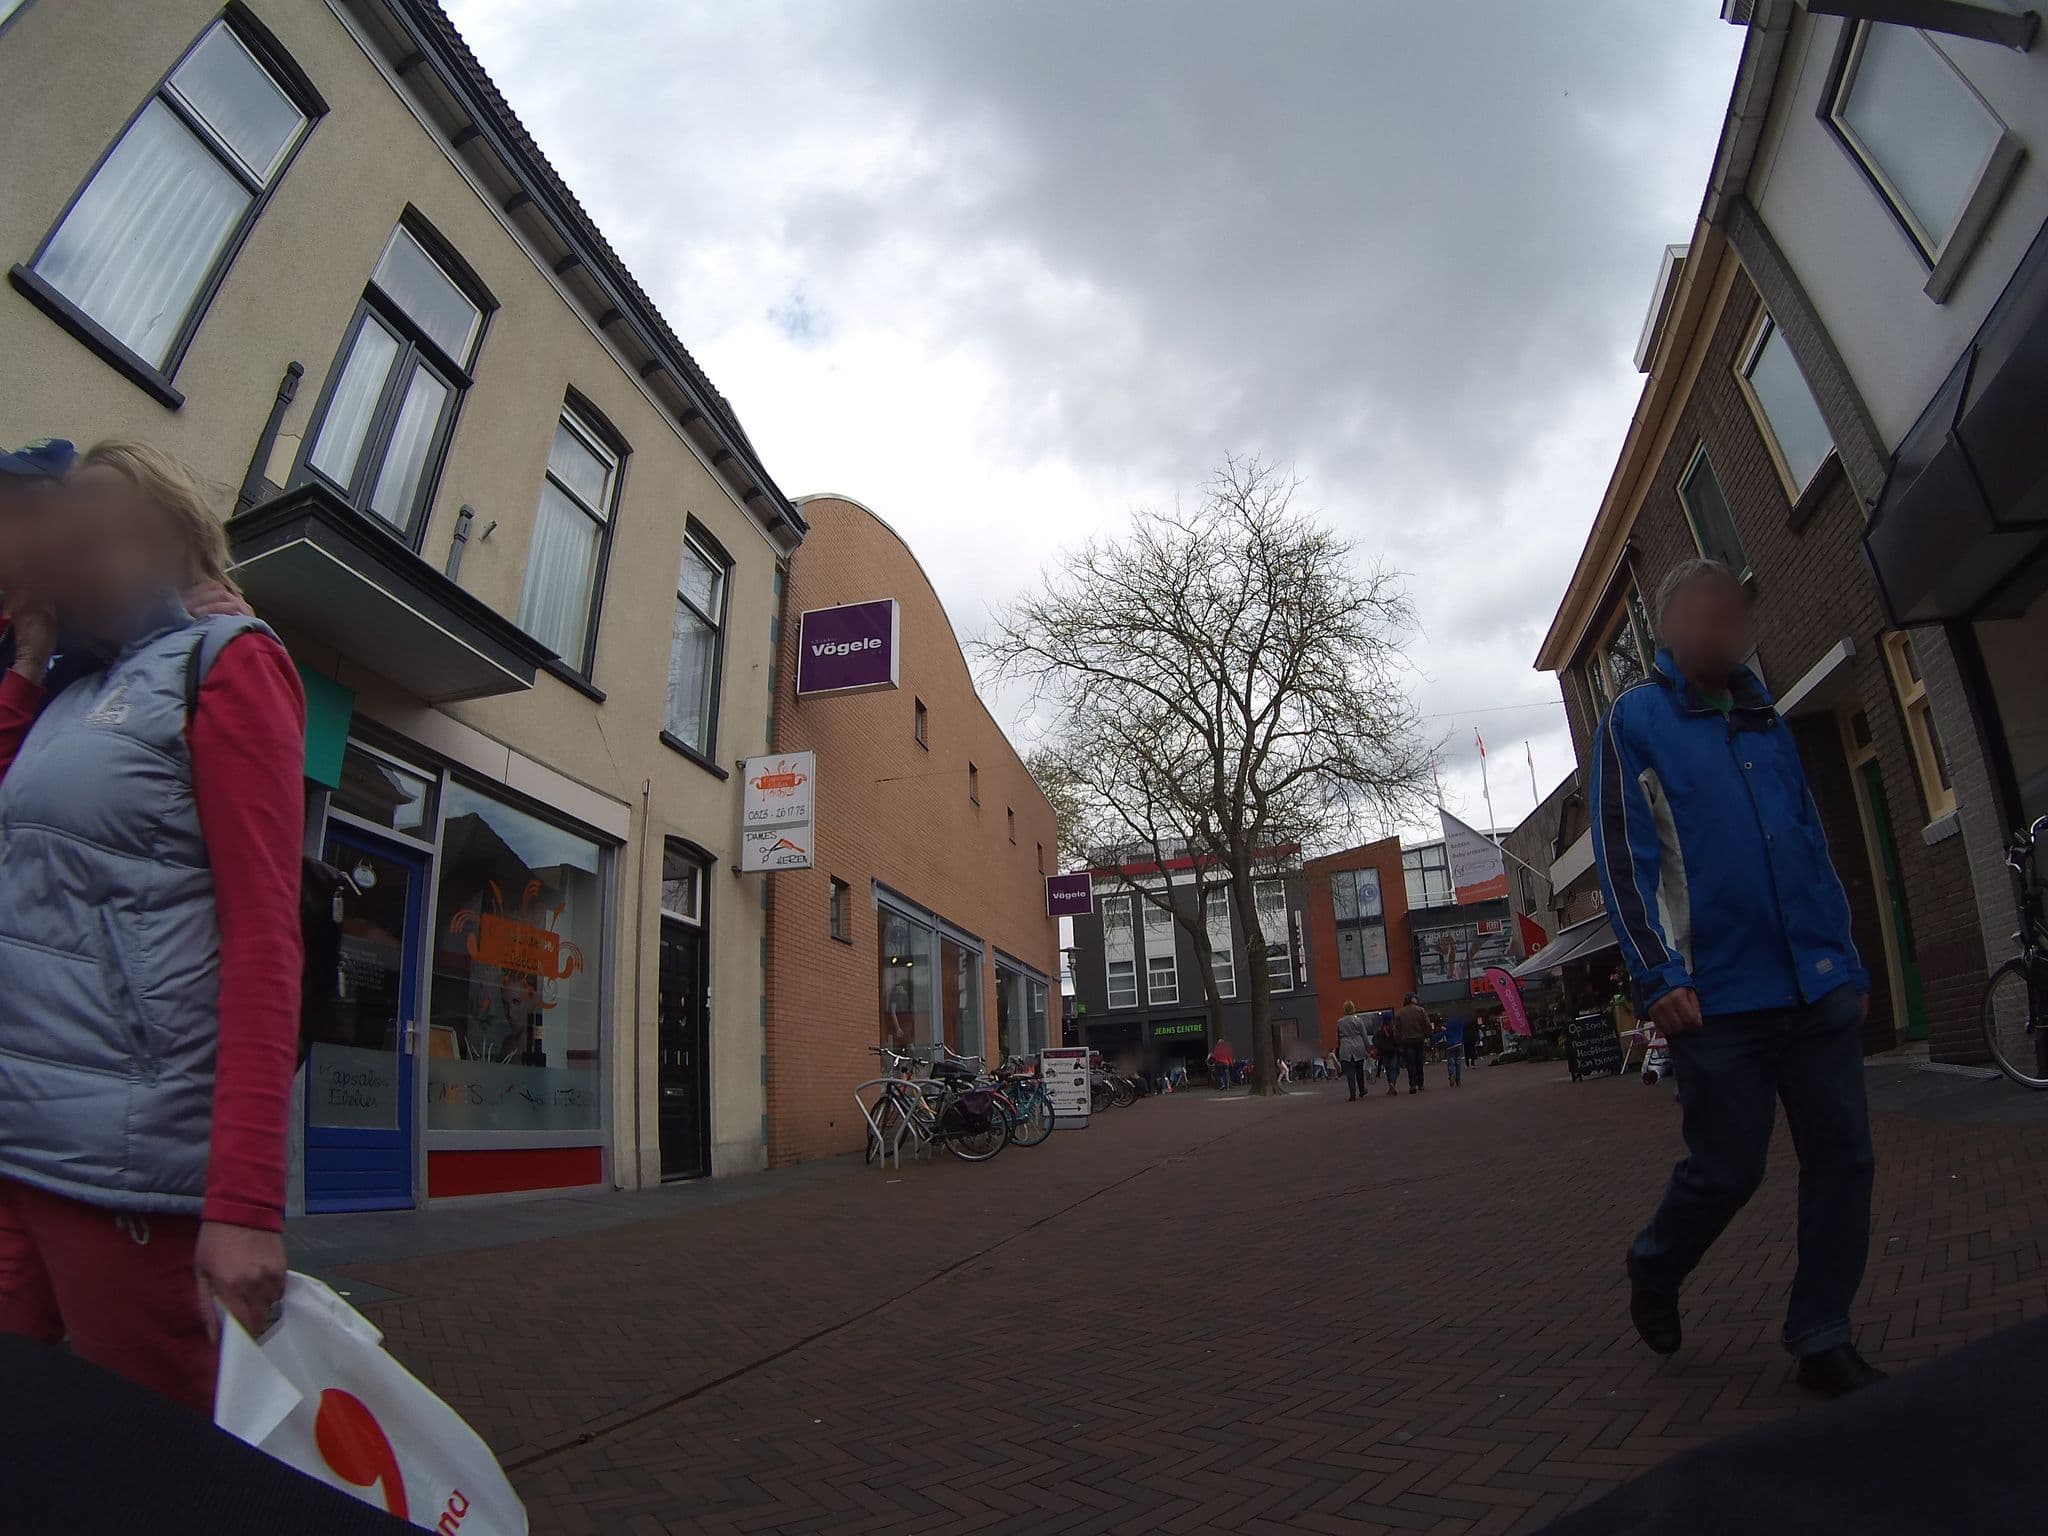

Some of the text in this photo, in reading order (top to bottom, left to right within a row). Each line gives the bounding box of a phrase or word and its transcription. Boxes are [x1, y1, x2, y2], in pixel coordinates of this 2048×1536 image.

[811, 637, 882, 657] Vögele
[746, 830, 778, 842] DAMES
[776, 854, 807, 865] HEREN
[1052, 890, 1087, 900] Vögele
[1154, 1023, 1204, 1036] JEANS CENTRE
[1568, 1019, 1608, 1038] Op zoek
